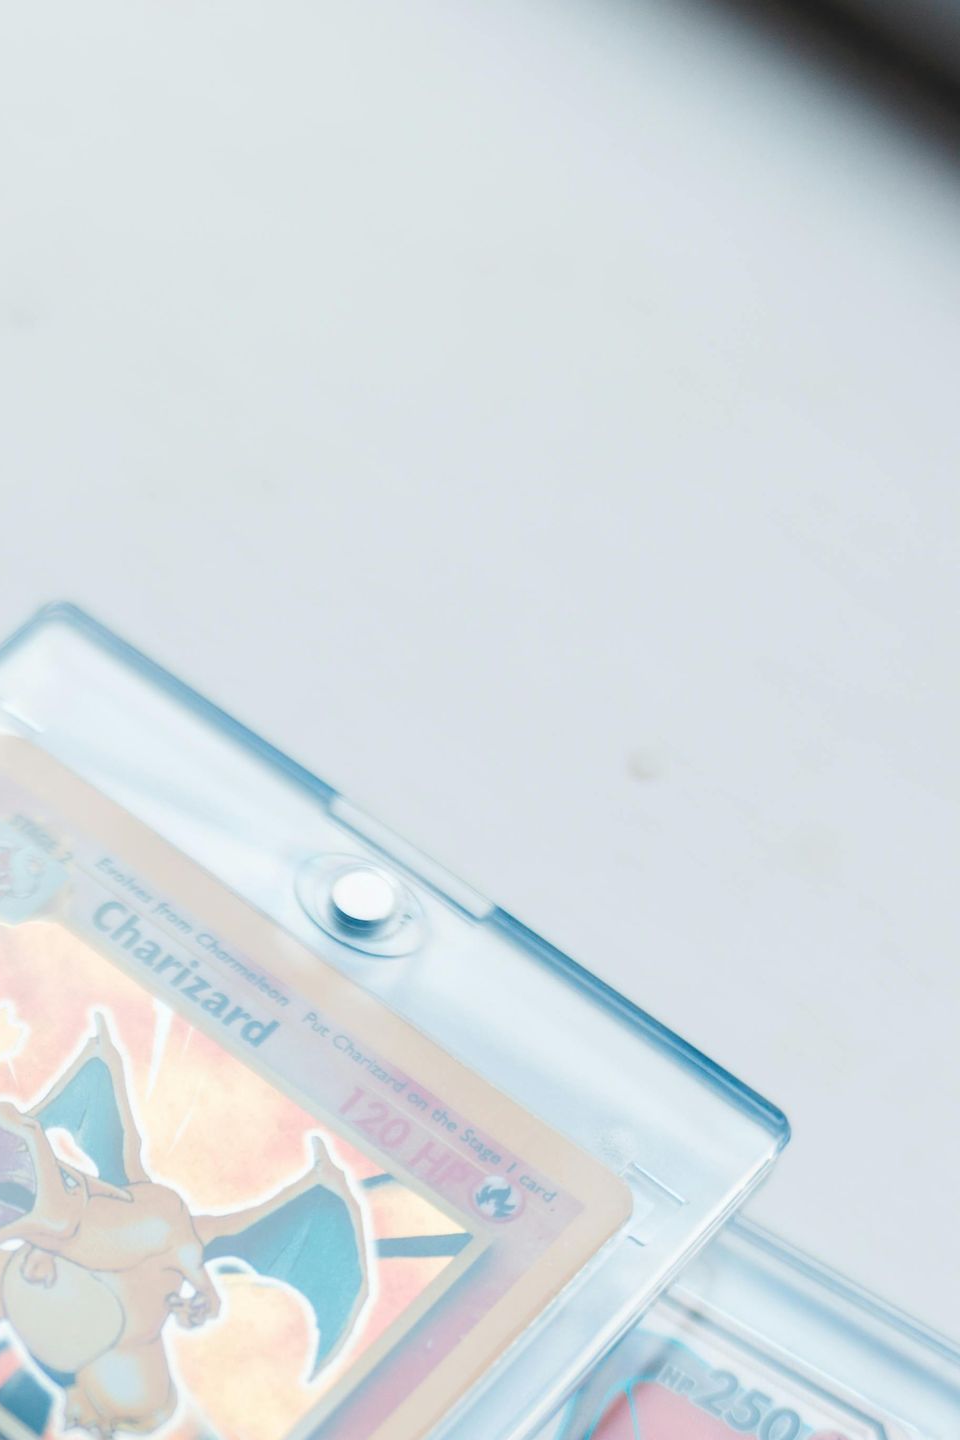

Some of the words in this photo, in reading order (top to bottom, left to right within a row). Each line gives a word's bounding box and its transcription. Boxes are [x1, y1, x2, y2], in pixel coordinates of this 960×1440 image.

[86, 898, 281, 1048] Charizard
[336, 1086, 415, 1151] 120
[407, 1140, 471, 1194] HP
[94, 857, 155, 903] Evolves
[151, 900, 197, 936] from
[194, 931, 293, 1006] Charmeleon
[300, 1011, 333, 1037] Put
[332, 1035, 407, 1092] Charizard
[405, 1091, 430, 1111] on
[430, 1107, 461, 1132] the
[457, 1128, 504, 1168] Stage
[517, 1171, 558, 1204] card
